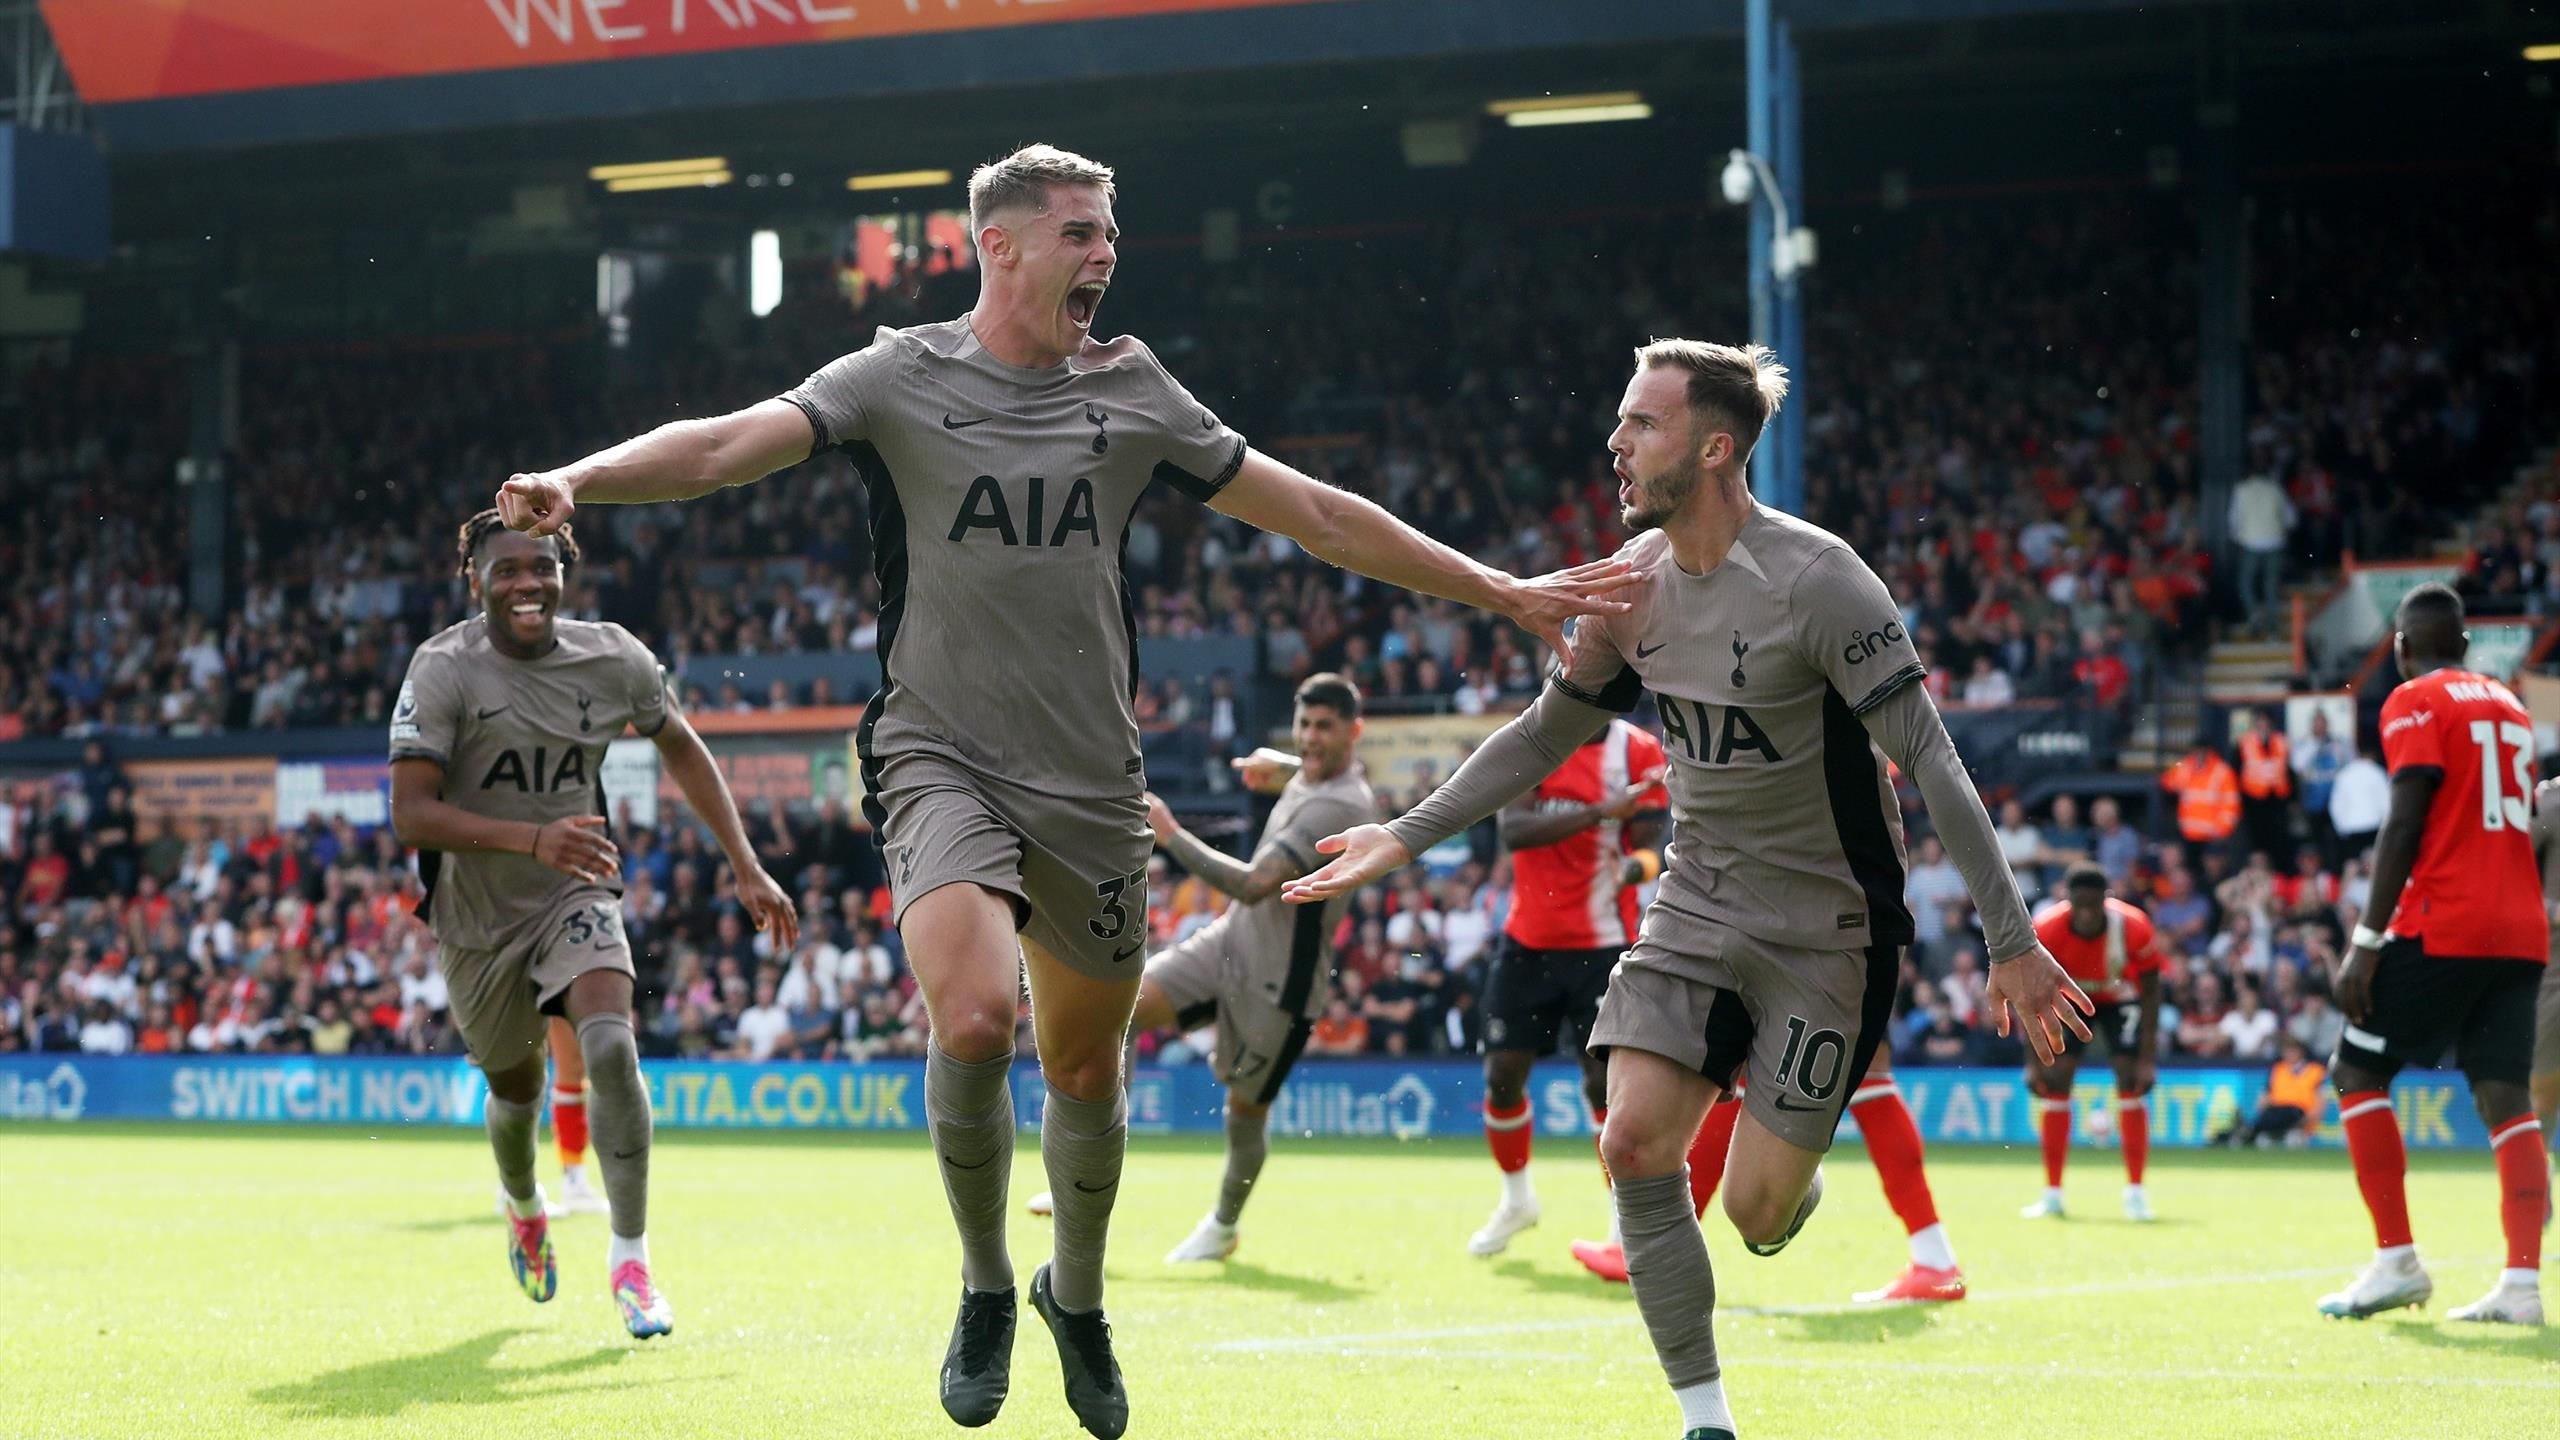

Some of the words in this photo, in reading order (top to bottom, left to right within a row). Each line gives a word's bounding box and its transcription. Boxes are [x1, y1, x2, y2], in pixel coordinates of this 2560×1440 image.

[948, 475, 1100, 547] AIA
[1844, 621, 1903, 665] cinc
[1656, 692, 1784, 765] AIA
[481, 746, 585, 793] AIA
[2469, 719, 2534, 833] 13
[1088, 863, 1147, 940] 37
[2119, 1004, 2141, 1043] 7
[1775, 1014, 1846, 1102] 10
[172, 1067, 349, 1119] SWITCH
[361, 1070, 480, 1119] NOW
[1267, 1082, 1386, 1134] tilita
[1939, 1081, 2013, 1138] AT
